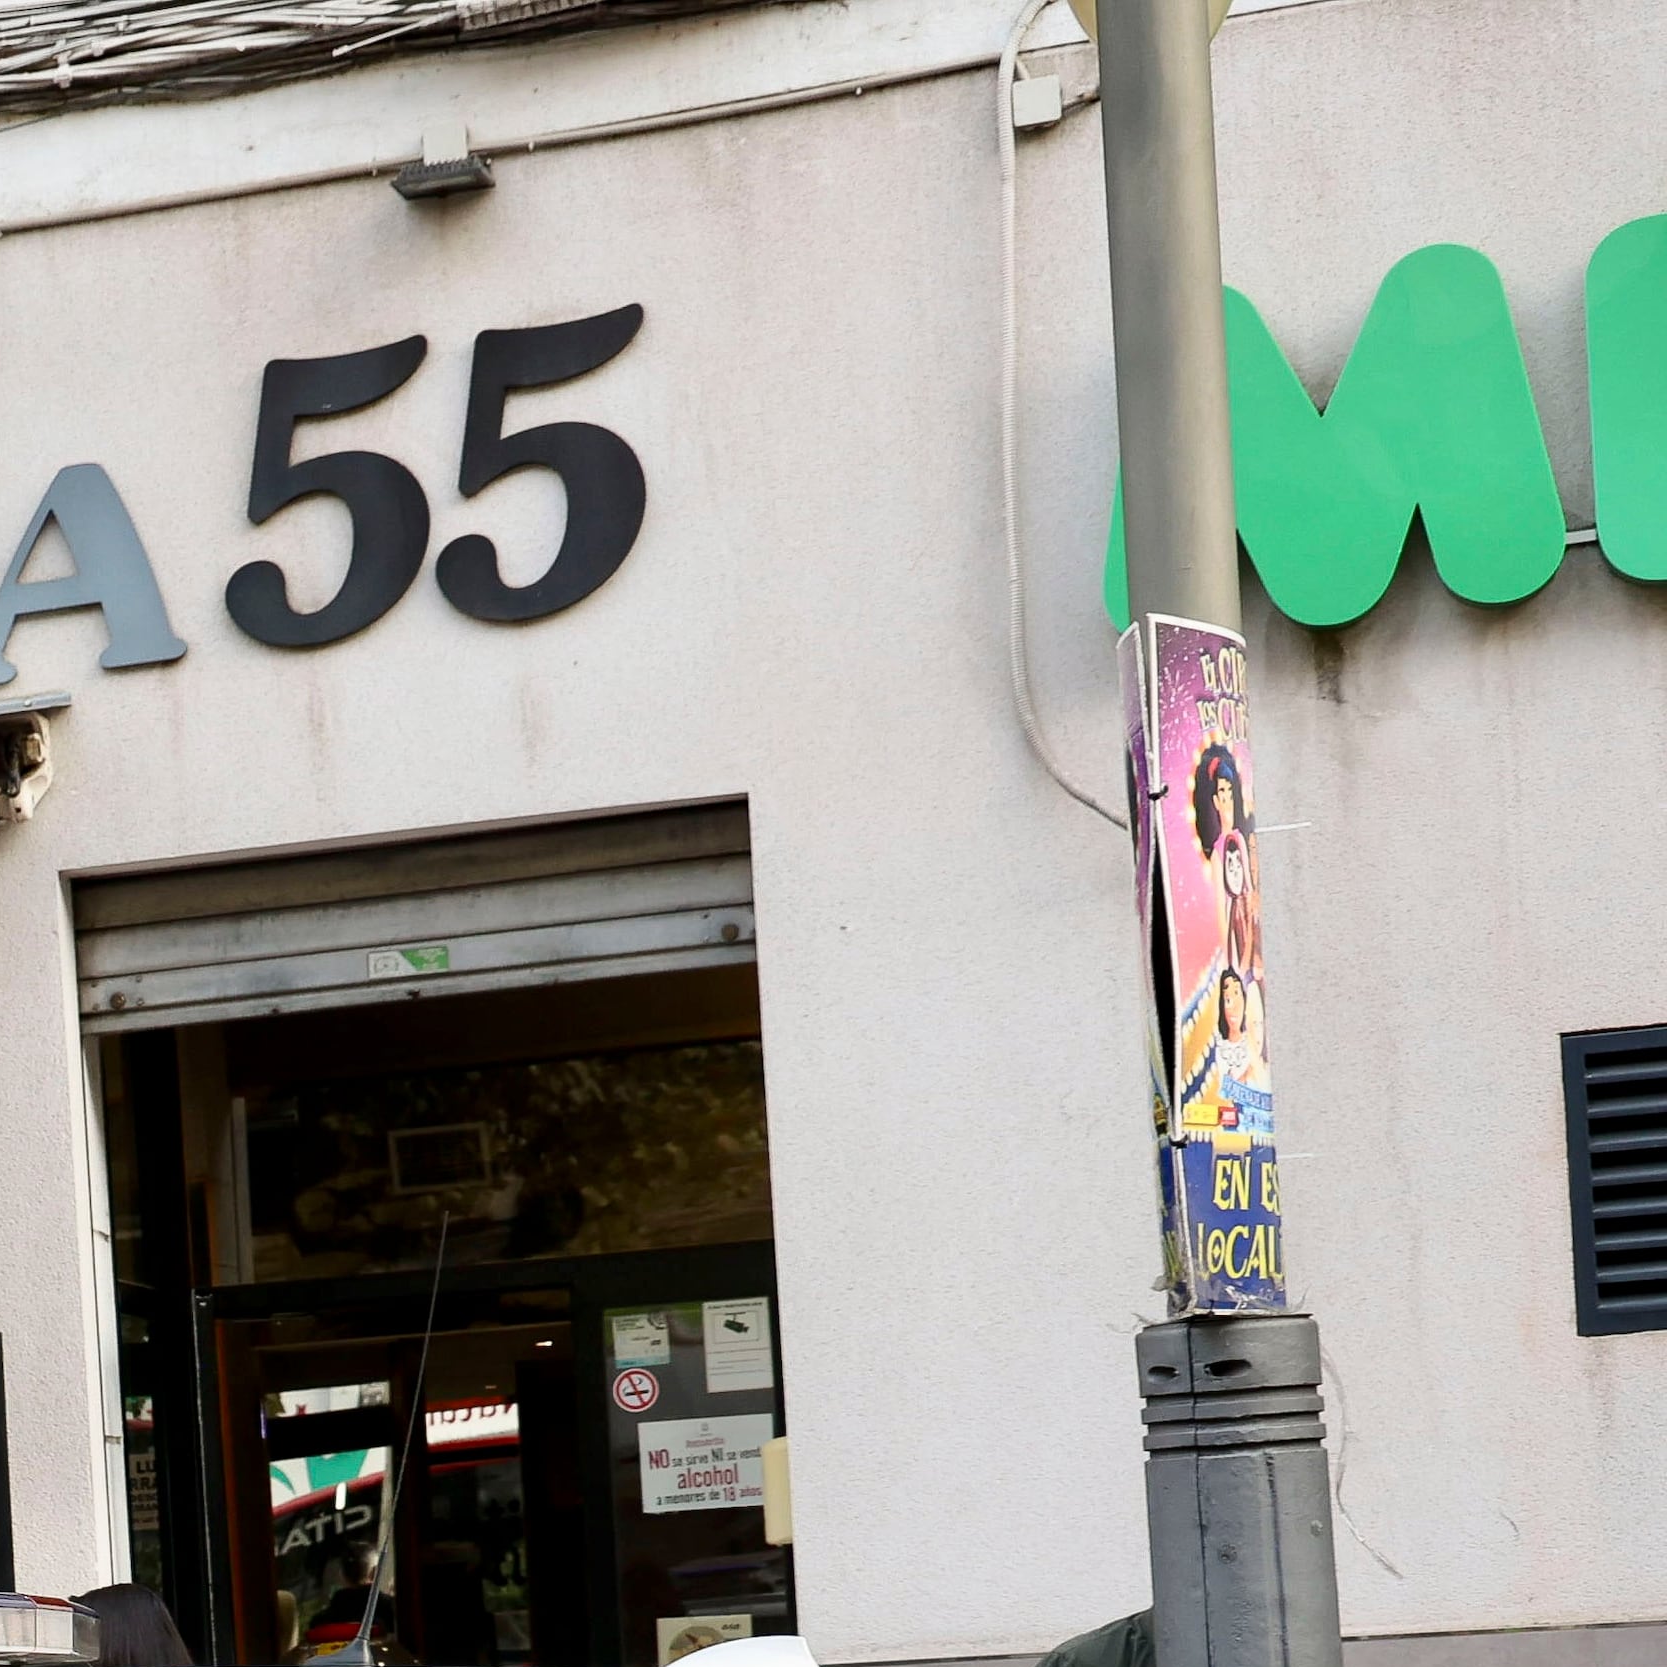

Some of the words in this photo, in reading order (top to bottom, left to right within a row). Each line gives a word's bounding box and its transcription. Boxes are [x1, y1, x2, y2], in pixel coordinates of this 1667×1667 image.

[225, 303, 646, 647] 55
[1213, 1155, 1252, 1211] EN
[648, 1448, 670, 1470] NO
[677, 1462, 740, 1490] alcohol
[665, 1491, 706, 1505] menores
[723, 1487, 736, 1502] 18
